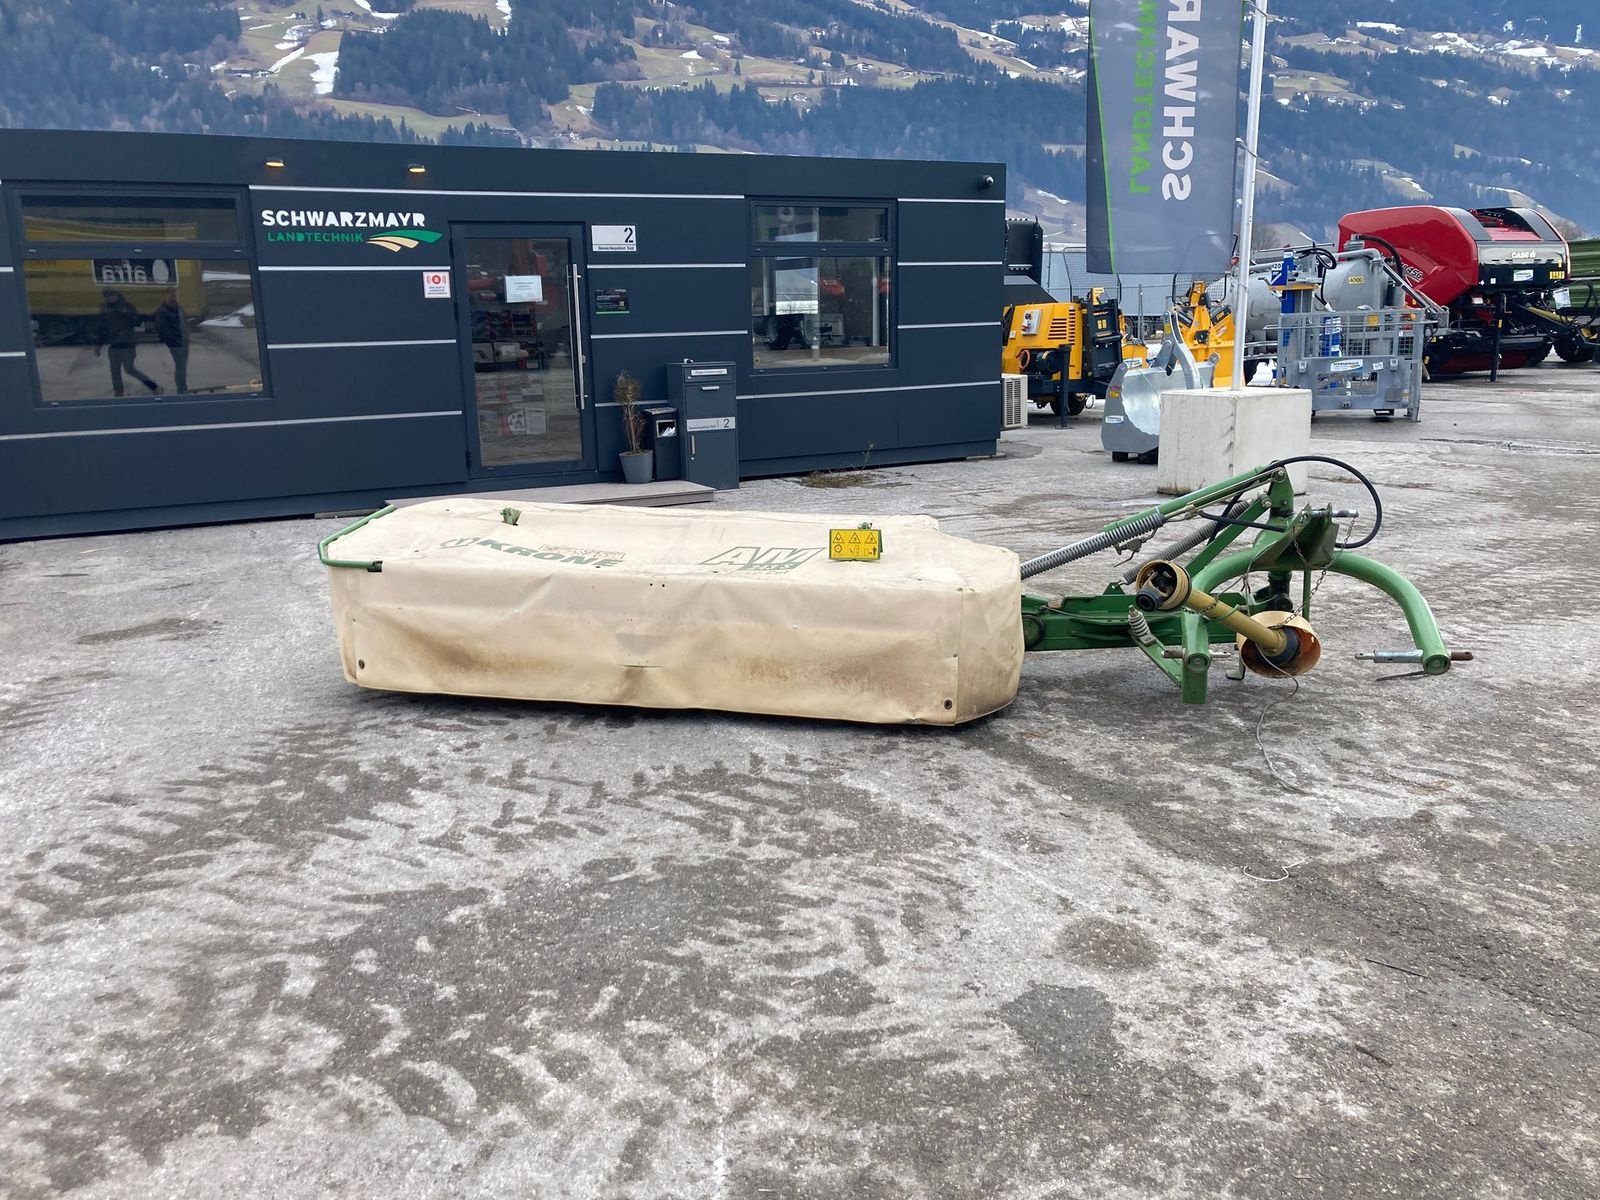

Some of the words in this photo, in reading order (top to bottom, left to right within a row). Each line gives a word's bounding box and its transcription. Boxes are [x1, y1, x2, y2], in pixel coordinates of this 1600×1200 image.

[261, 209, 425, 227] SCHWARZMAYR
[267, 231, 364, 242] LANDTECHNIK
[624, 227, 634, 243] 2
[1511, 251, 1530, 259] CASE
[724, 418, 730, 428] 2
[476, 538, 624, 567] KRONE
[698, 546, 828, 566] AM
